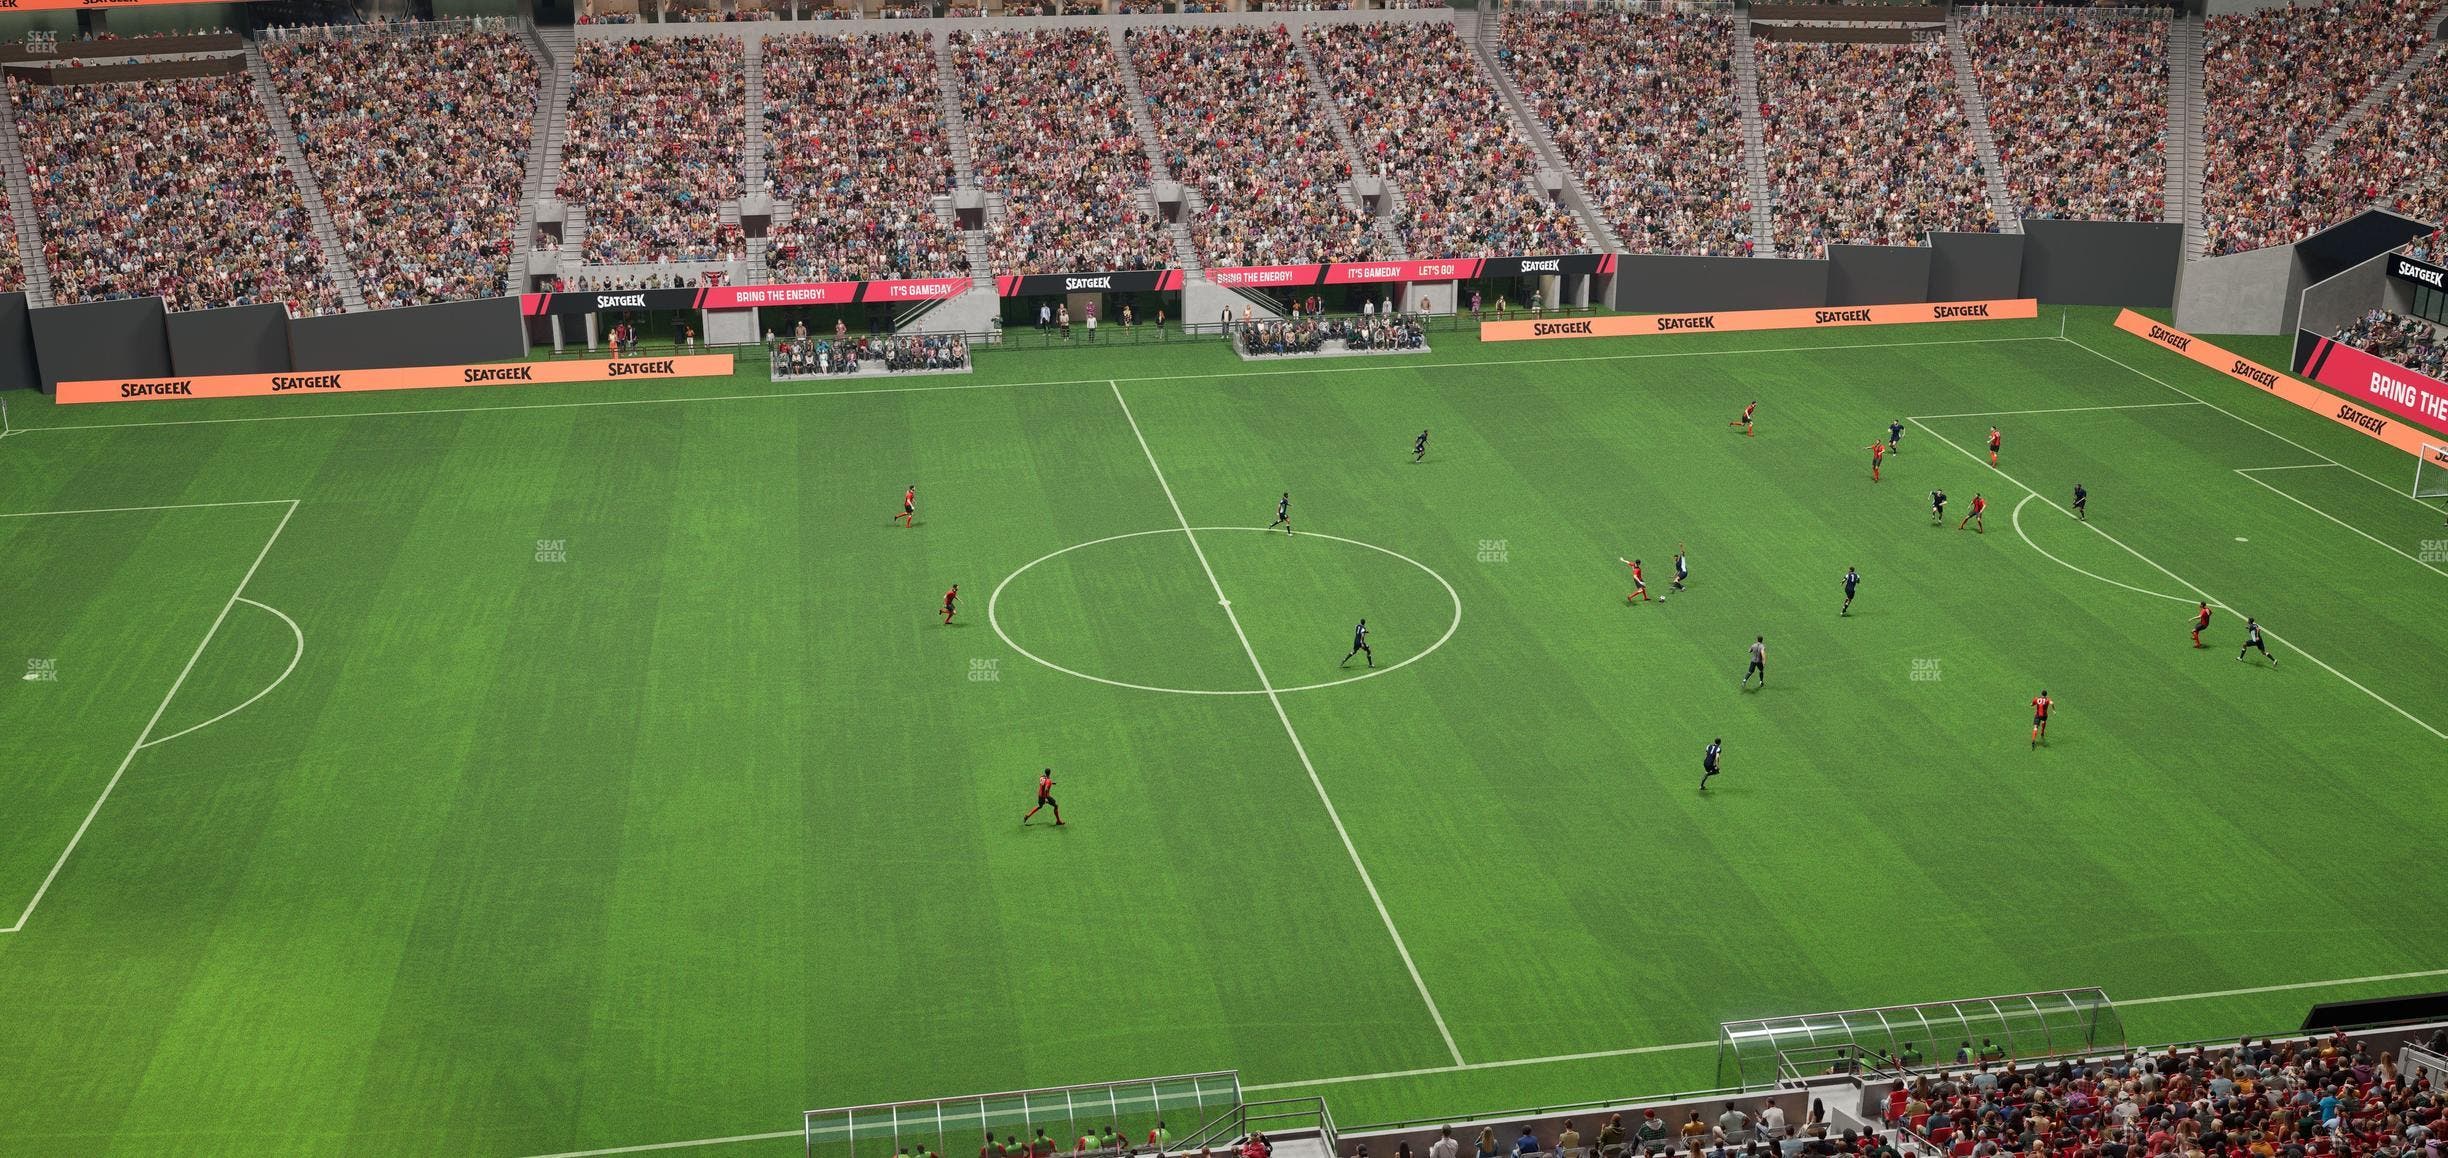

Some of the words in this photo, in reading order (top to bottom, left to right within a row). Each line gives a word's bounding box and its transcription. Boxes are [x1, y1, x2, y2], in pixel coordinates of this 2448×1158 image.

[1348, 268, 1363, 279] IT'S
[1364, 266, 1402, 278] GAMEDAY
[1419, 265, 1440, 275] LET'S
[1441, 265, 1455, 275] GO!
[1521, 259, 1560, 272] SEATGEEK
[1243, 272, 1258, 283] THE
[1259, 271, 1293, 282] ENERGY!
[2398, 260, 2444, 288] SEATGEEK
[890, 286, 907, 297] IT'S
[909, 284, 953, 296] GAMEDAY
[1066, 276, 1111, 290] SEATGEEK
[597, 294, 646, 308] SEATGEEK
[737, 291, 765, 303] BRING
[767, 290, 785, 301] THE
[786, 288, 825, 301] ENERGY!
[1815, 309, 1872, 324] SEATGEEK
[1934, 304, 1989, 318] SEATGEEK
[1534, 321, 1593, 336] SEATGEEK
[1657, 316, 1716, 331] SEATGEEK
[2149, 325, 2191, 352] SEATGEEK
[464, 366, 532, 382] SEATGEEK
[608, 361, 675, 376] SEATGEEK
[2231, 360, 2280, 390] SEATGEEK
[121, 381, 192, 397] SEATGEEK
[272, 375, 341, 391] SEATGEEK
[2370, 372, 2417, 408] BRING
[2420, 391, 2448, 422] THE
[2337, 404, 2388, 436] SEATGEEK
